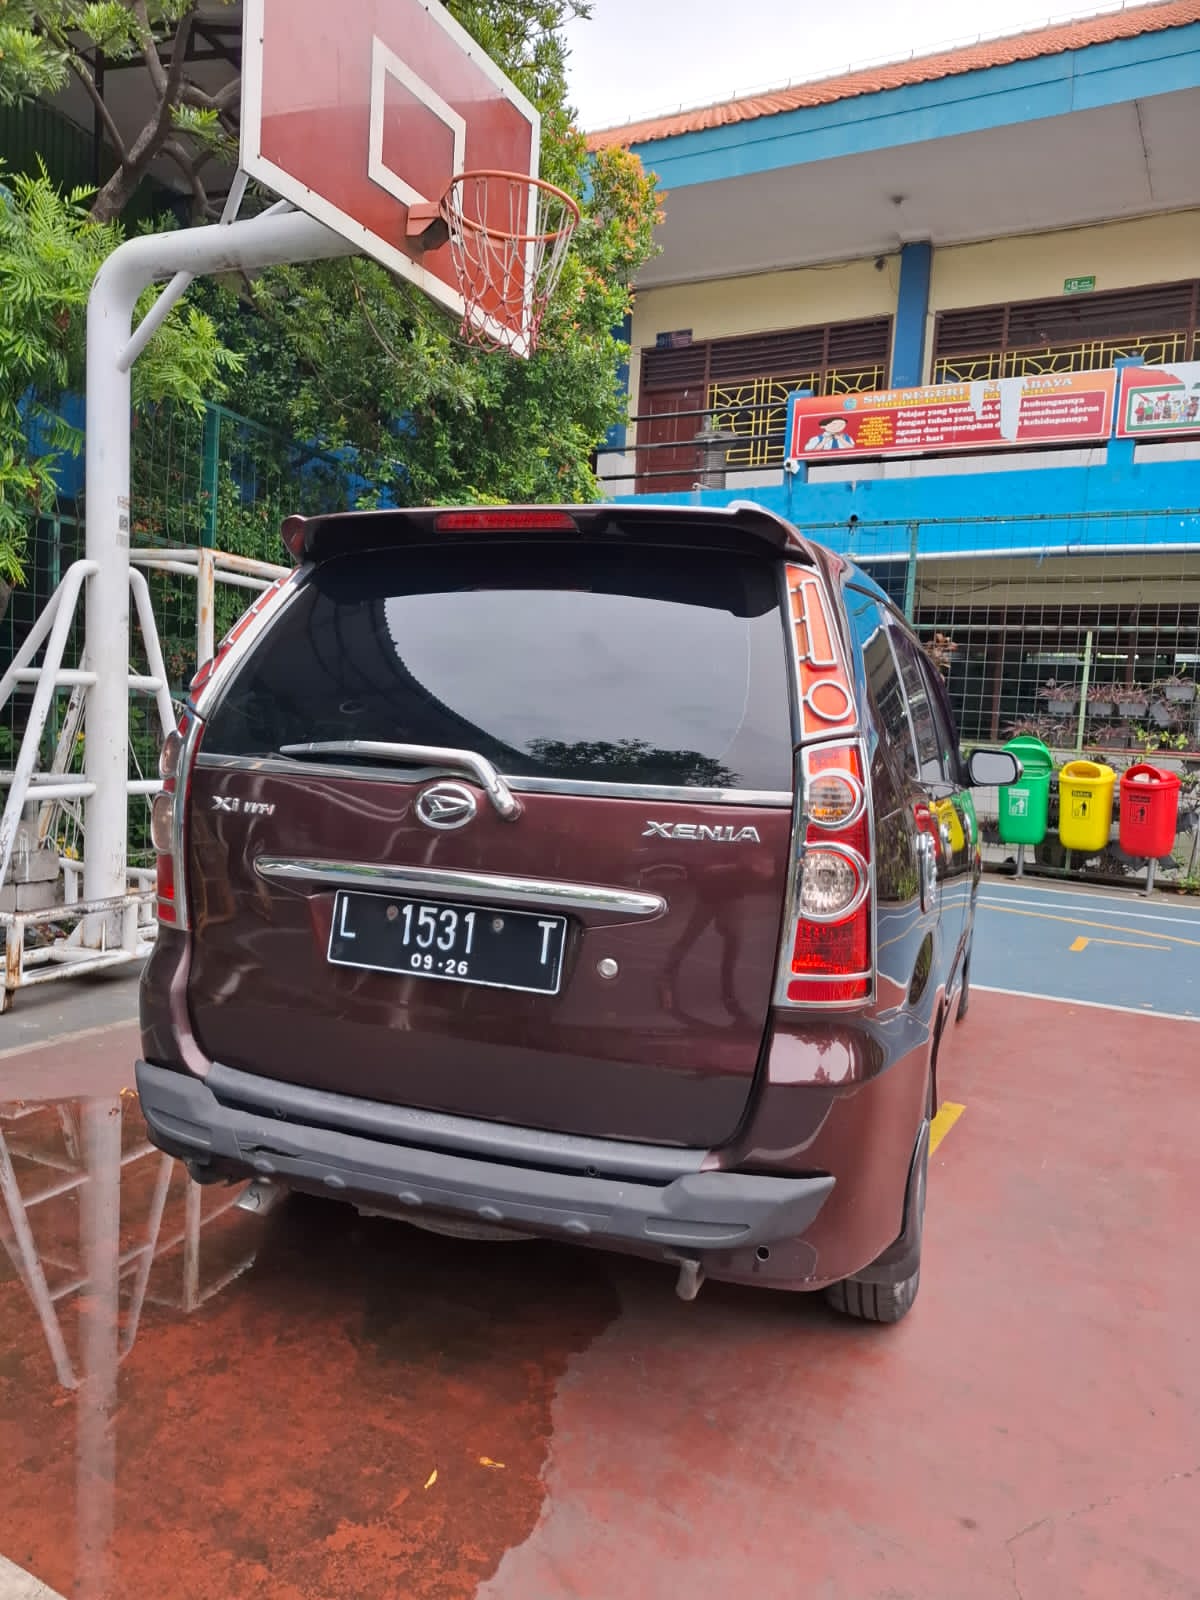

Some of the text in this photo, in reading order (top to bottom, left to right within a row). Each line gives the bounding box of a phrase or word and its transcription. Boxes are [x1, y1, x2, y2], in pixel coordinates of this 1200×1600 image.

[211, 795, 240, 812] Xi
[641, 820, 761, 843] XENIA
[339, 896, 558, 965] L 1531 T
